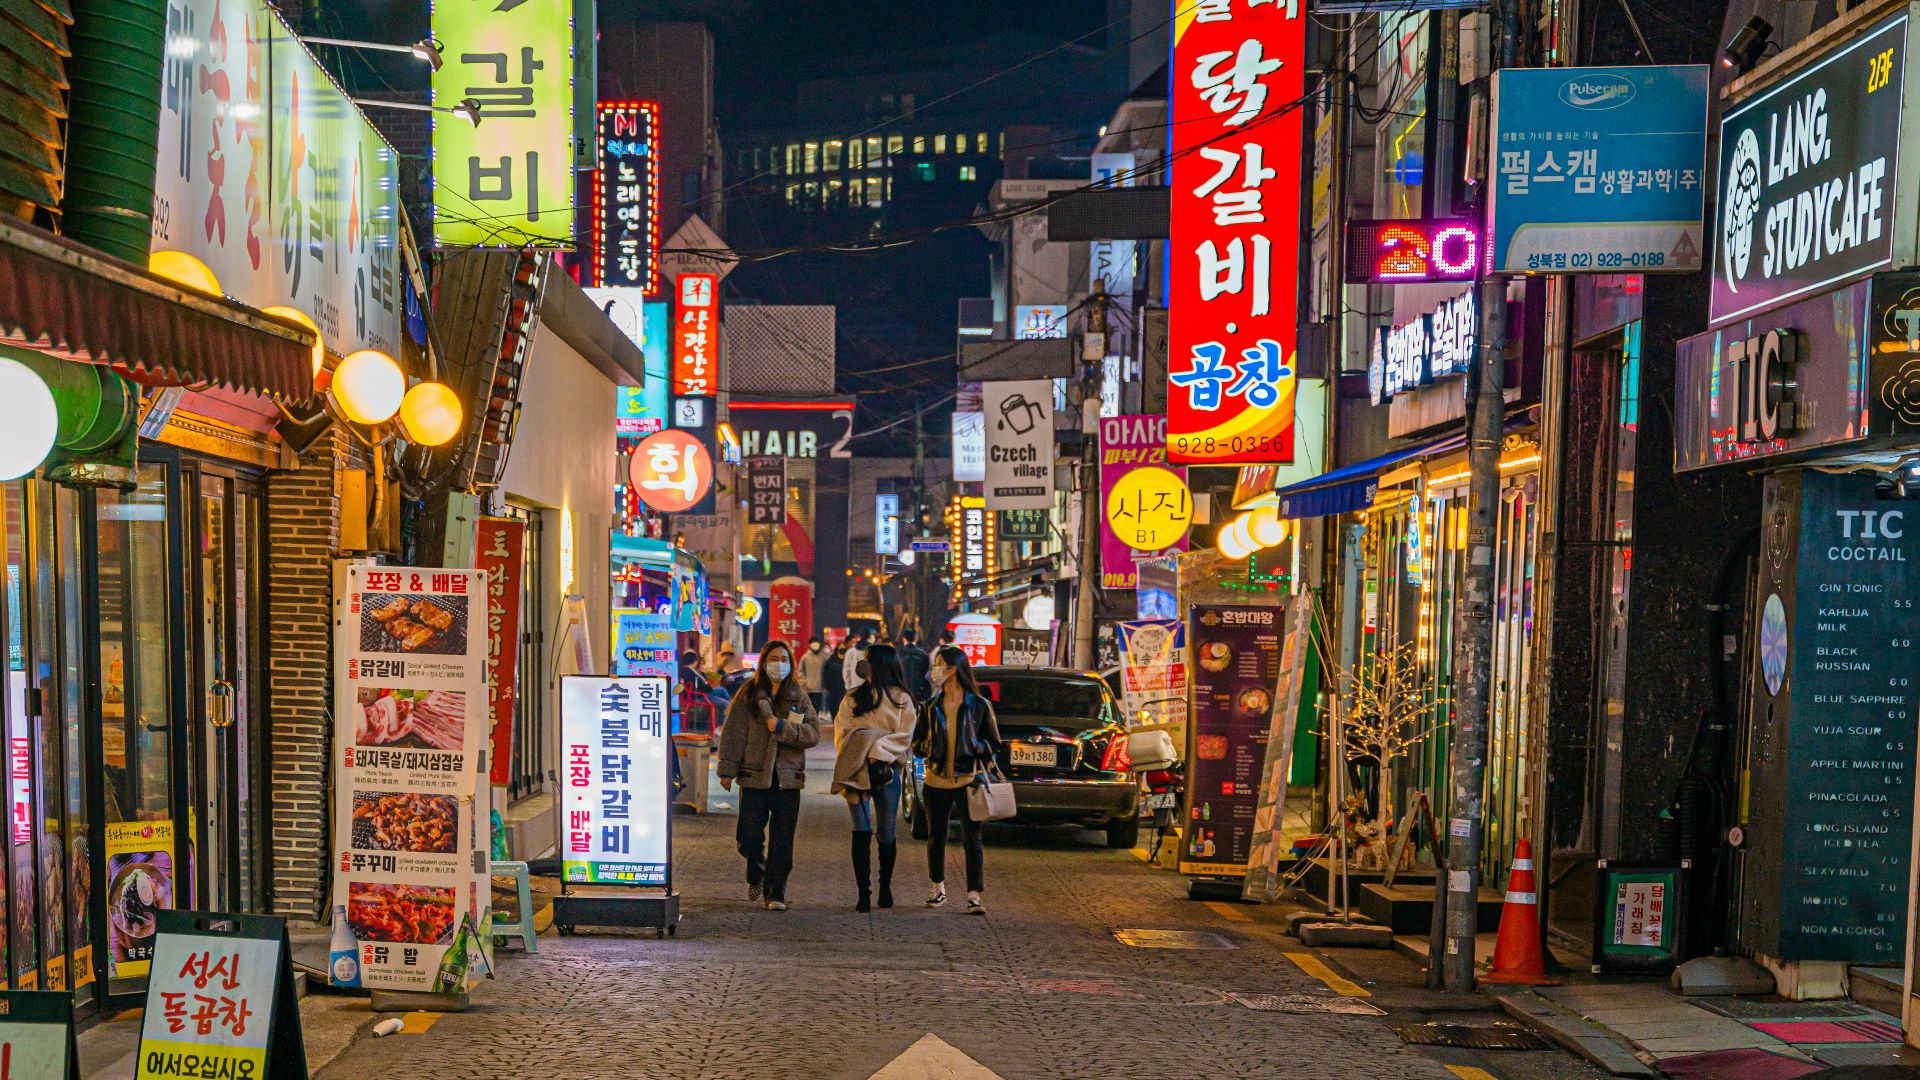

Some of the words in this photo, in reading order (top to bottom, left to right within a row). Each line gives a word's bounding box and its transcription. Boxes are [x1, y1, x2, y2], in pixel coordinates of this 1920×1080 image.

[1867, 47, 1894, 94] 2/3F
[1569, 82, 1630, 98] Pulsecam
[461, 47, 544, 222] 갈비
[614, 113, 638, 137] M
[1768, 87, 1831, 187] LANG.
[1191, 39, 1284, 316] 닭갈비
[1501, 149, 1598, 195] 펄스캠
[1763, 157, 1886, 279] STUDYCAFE
[1527, 253, 1567, 270] 성북점
[1571, 253, 1593, 268] 02)
[1597, 252, 1665, 267] 928-0188
[1169, 338, 1293, 411] 곱창
[1729, 330, 1782, 442] TIC
[742, 430, 817, 458] HAIR
[830, 410, 853, 458] 2
[990, 443, 1036, 463] Czech
[1177, 436, 1284, 454] 928-0356
[641, 443, 698, 502] 회
[1013, 464, 1048, 479] village
[1112, 488, 1185, 524] 사진
[1836, 510, 1904, 539] TIC
[1136, 530, 1156, 544] B1
[1828, 547, 1906, 561] COCTAIL
[366, 572, 402, 592] 포장
[409, 573, 424, 592] &
[432, 573, 468, 594] 배달
[1819, 583, 1841, 593] GIN
[1846, 584, 1883, 593] TONIC
[1221, 610, 1274, 625] 혼밥대왕
[1819, 608, 1869, 617] KAHLUA
[1817, 623, 1847, 632] MILK
[1816, 647, 1858, 656] BLACK
[361, 660, 405, 679] 닭갈비
[1816, 662, 1871, 671] RUSSIAN
[1814, 694, 1845, 703] BLUE
[638, 683, 663, 738] 할매
[1813, 726, 1844, 735] YUJA
[1848, 727, 1882, 736] SOUR
[355, 751, 464, 771] 돼지목살/돼지삼겹살
[570, 744, 592, 787] 포장
[601, 682, 632, 854] 숯불닭갈비
[1811, 760, 1849, 769] APPLE
[1852, 760, 1904, 770] MARTINI
[570, 810, 592, 853] 배달
[1843, 825, 1889, 834] ISLAND
[352, 854, 396, 874] 쭈꾸미
[1648, 884, 1665, 943] 담배꽁초
[1802, 925, 1827, 934] NON
[1831, 926, 1886, 936] ALCOHOL
[375, 946, 389, 965] 닭
[404, 948, 418, 966] 발
[178, 951, 241, 991] 성신
[160, 991, 253, 1037] 돌곱창
[146, 1050, 256, 1080] 어서오십시오
